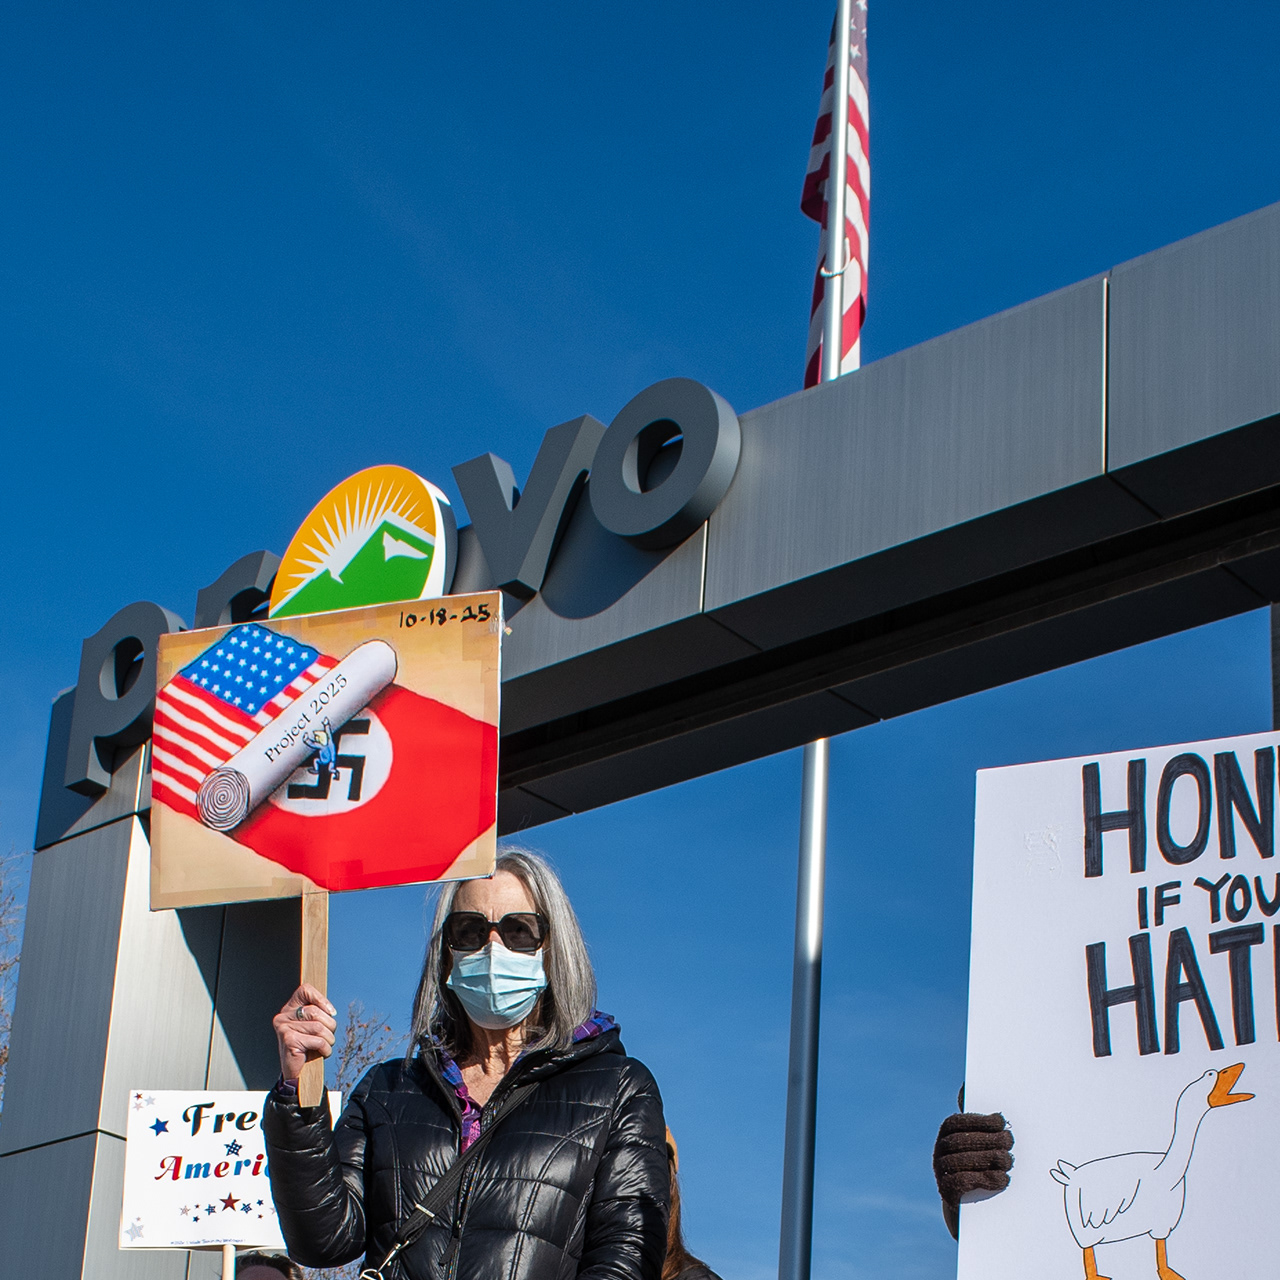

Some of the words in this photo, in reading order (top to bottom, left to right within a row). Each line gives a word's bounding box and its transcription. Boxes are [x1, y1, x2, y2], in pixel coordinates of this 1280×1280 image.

[264, 712, 311, 763] Project
[310, 673, 348, 715] 2025
[1137, 880, 1182, 930] IF
[182, 1101, 265, 1137] Fre
[154, 1153, 270, 1182] Ameri
